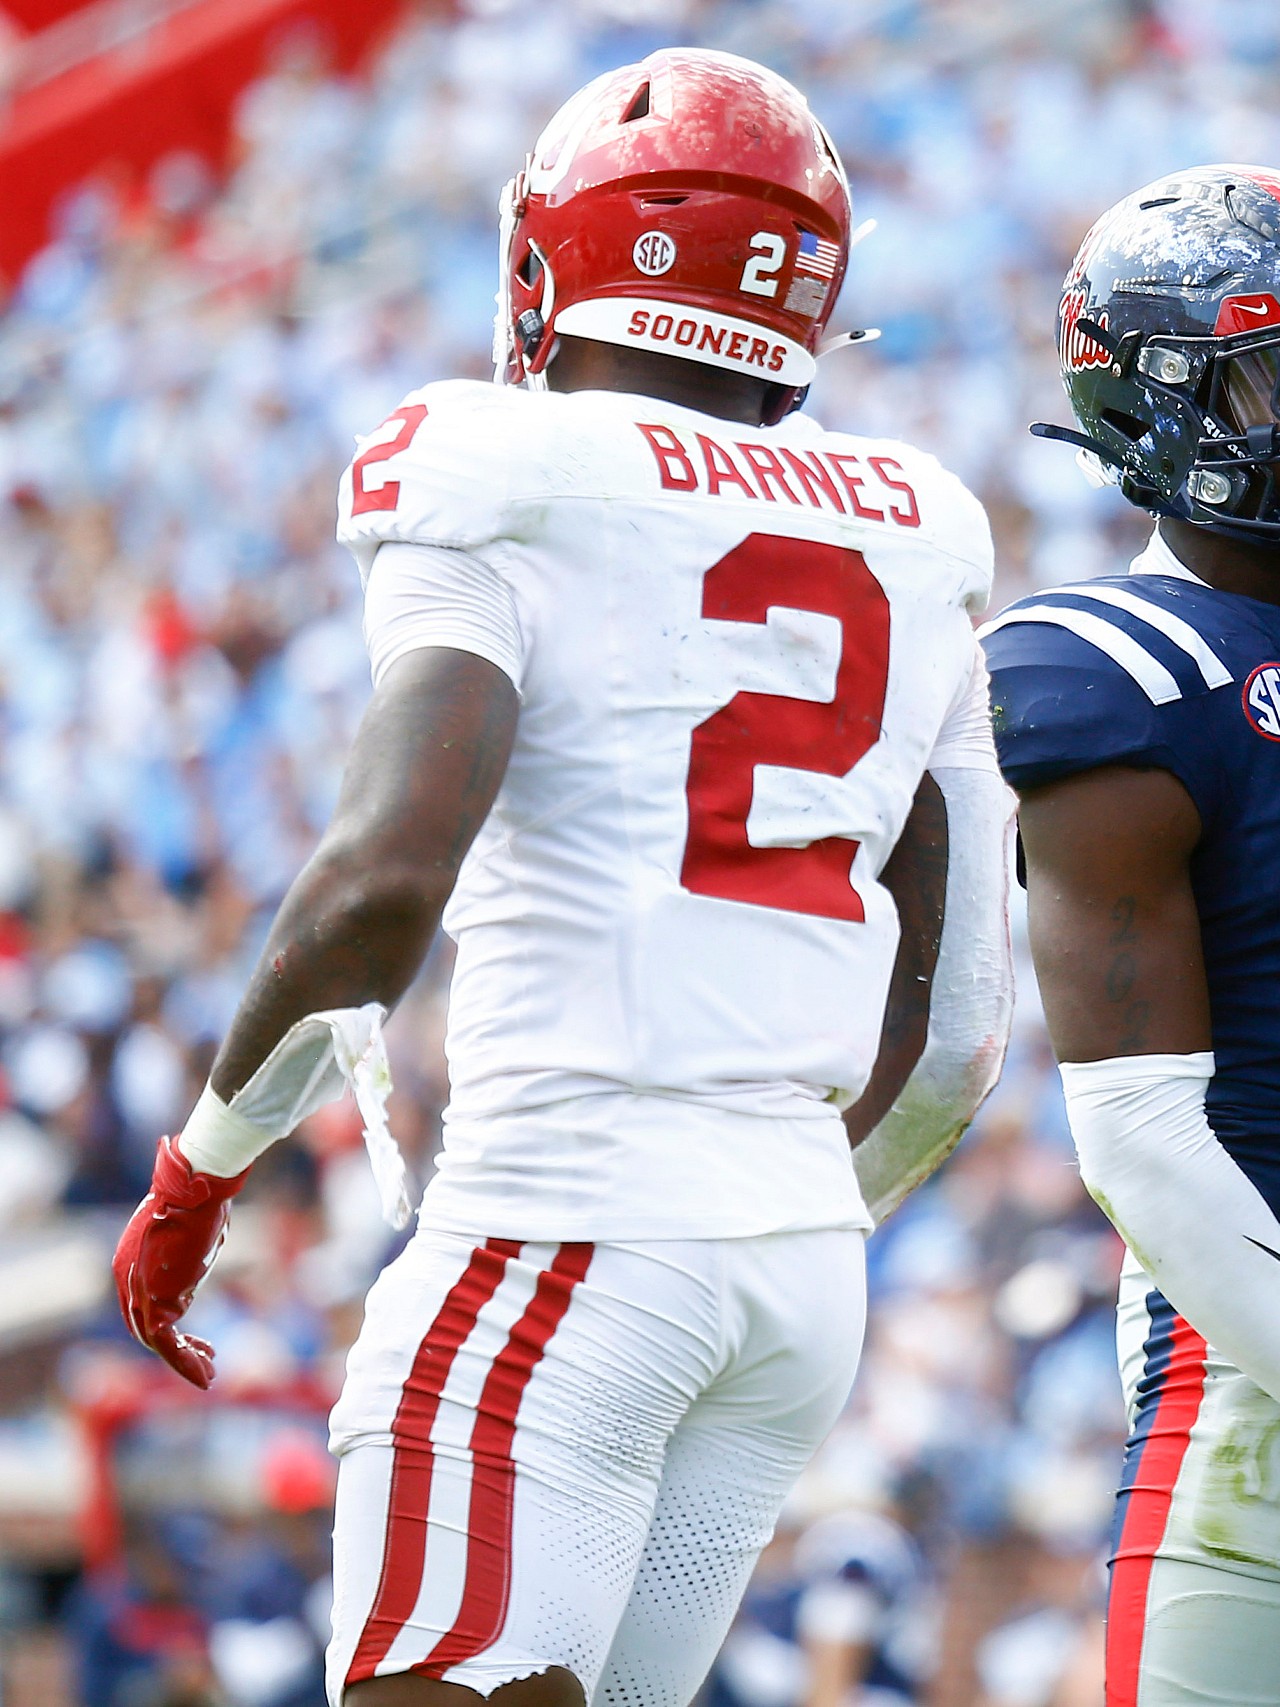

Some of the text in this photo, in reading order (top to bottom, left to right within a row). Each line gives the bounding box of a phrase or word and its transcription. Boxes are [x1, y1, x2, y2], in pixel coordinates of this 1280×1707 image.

[638, 236, 670, 270] SEC
[738, 230, 787, 298] 2
[627, 310, 788, 373] SOONERS
[351, 403, 429, 517] 2
[634, 421, 921, 528] BARNES
[679, 532, 891, 924] 2
